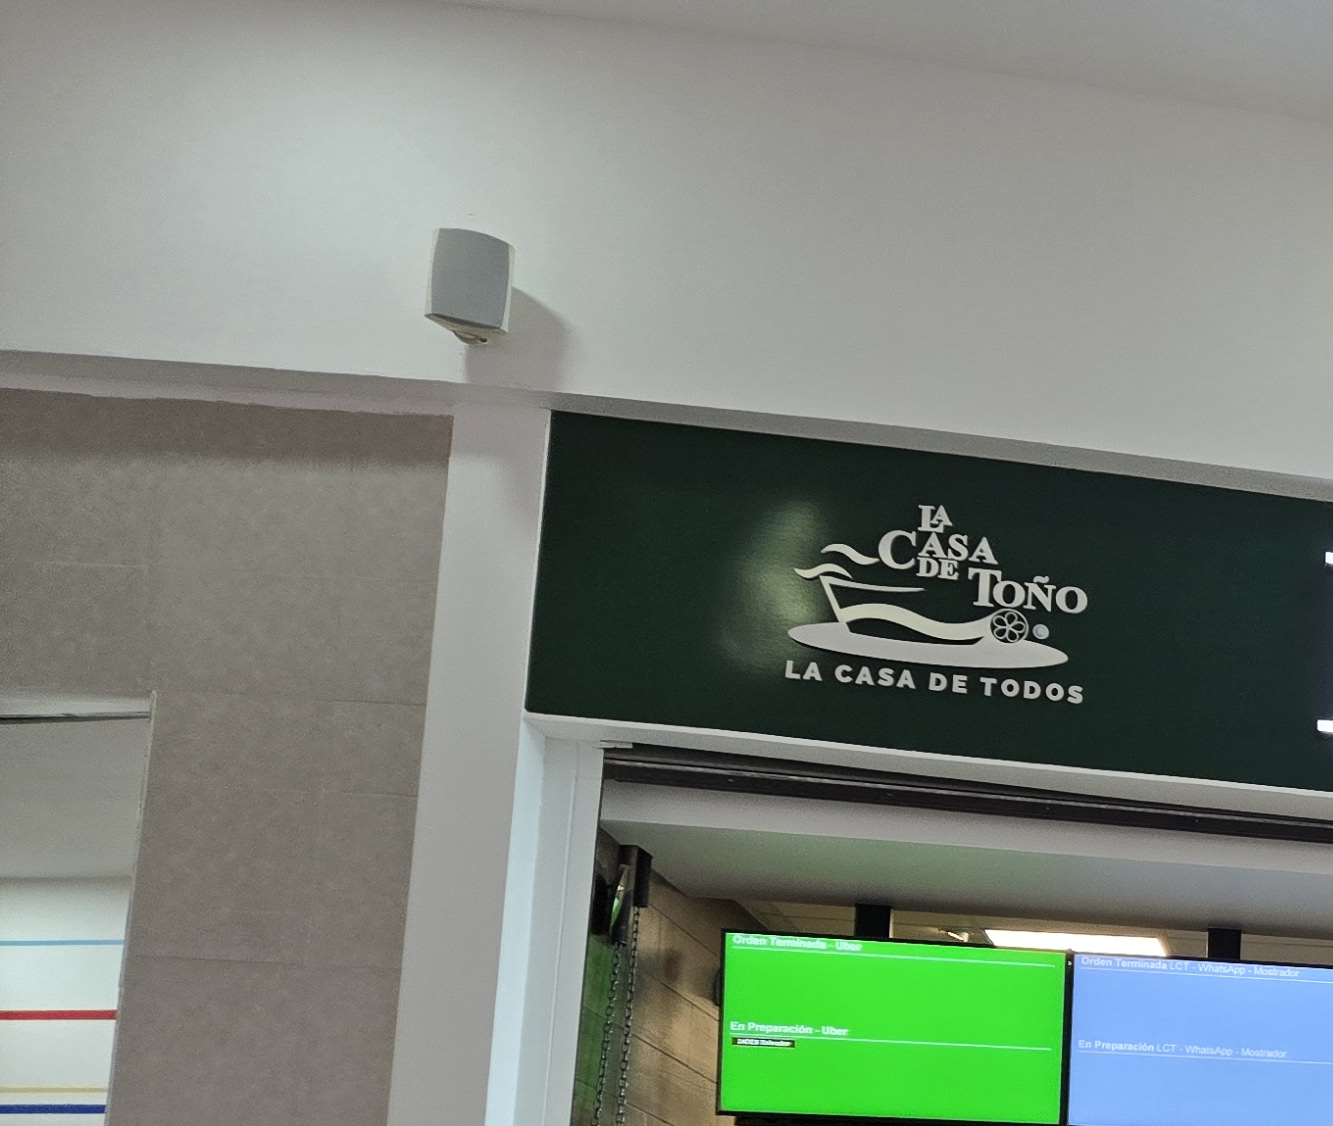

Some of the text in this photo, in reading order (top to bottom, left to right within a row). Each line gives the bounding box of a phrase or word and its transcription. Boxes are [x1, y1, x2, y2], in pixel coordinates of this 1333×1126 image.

[918, 504, 953, 533] LA
[878, 530, 999, 570] CASA
[916, 557, 959, 580] DE
[968, 567, 1088, 614] TOÑO
[785, 660, 1084, 704] LA CASA DE TODOS
[1081, 956, 1112, 967] Orden
[1116, 958, 1167, 971] Terminada
[1169, 961, 1190, 971] LCT
[1198, 963, 1246, 976] WhatsApp
[1253, 966, 1300, 978] Mostrador
[730, 1021, 746, 1031] En
[747, 1022, 813, 1035] Preparación
[821, 1025, 850, 1036] Uber
[1078, 1039, 1092, 1049] En
[1094, 1040, 1154, 1053] Preparación
[1156, 1043, 1177, 1053] LCT
[1185, 1045, 1233, 1057] WhatsApp
[1241, 1047, 1288, 1059] Mostrador
